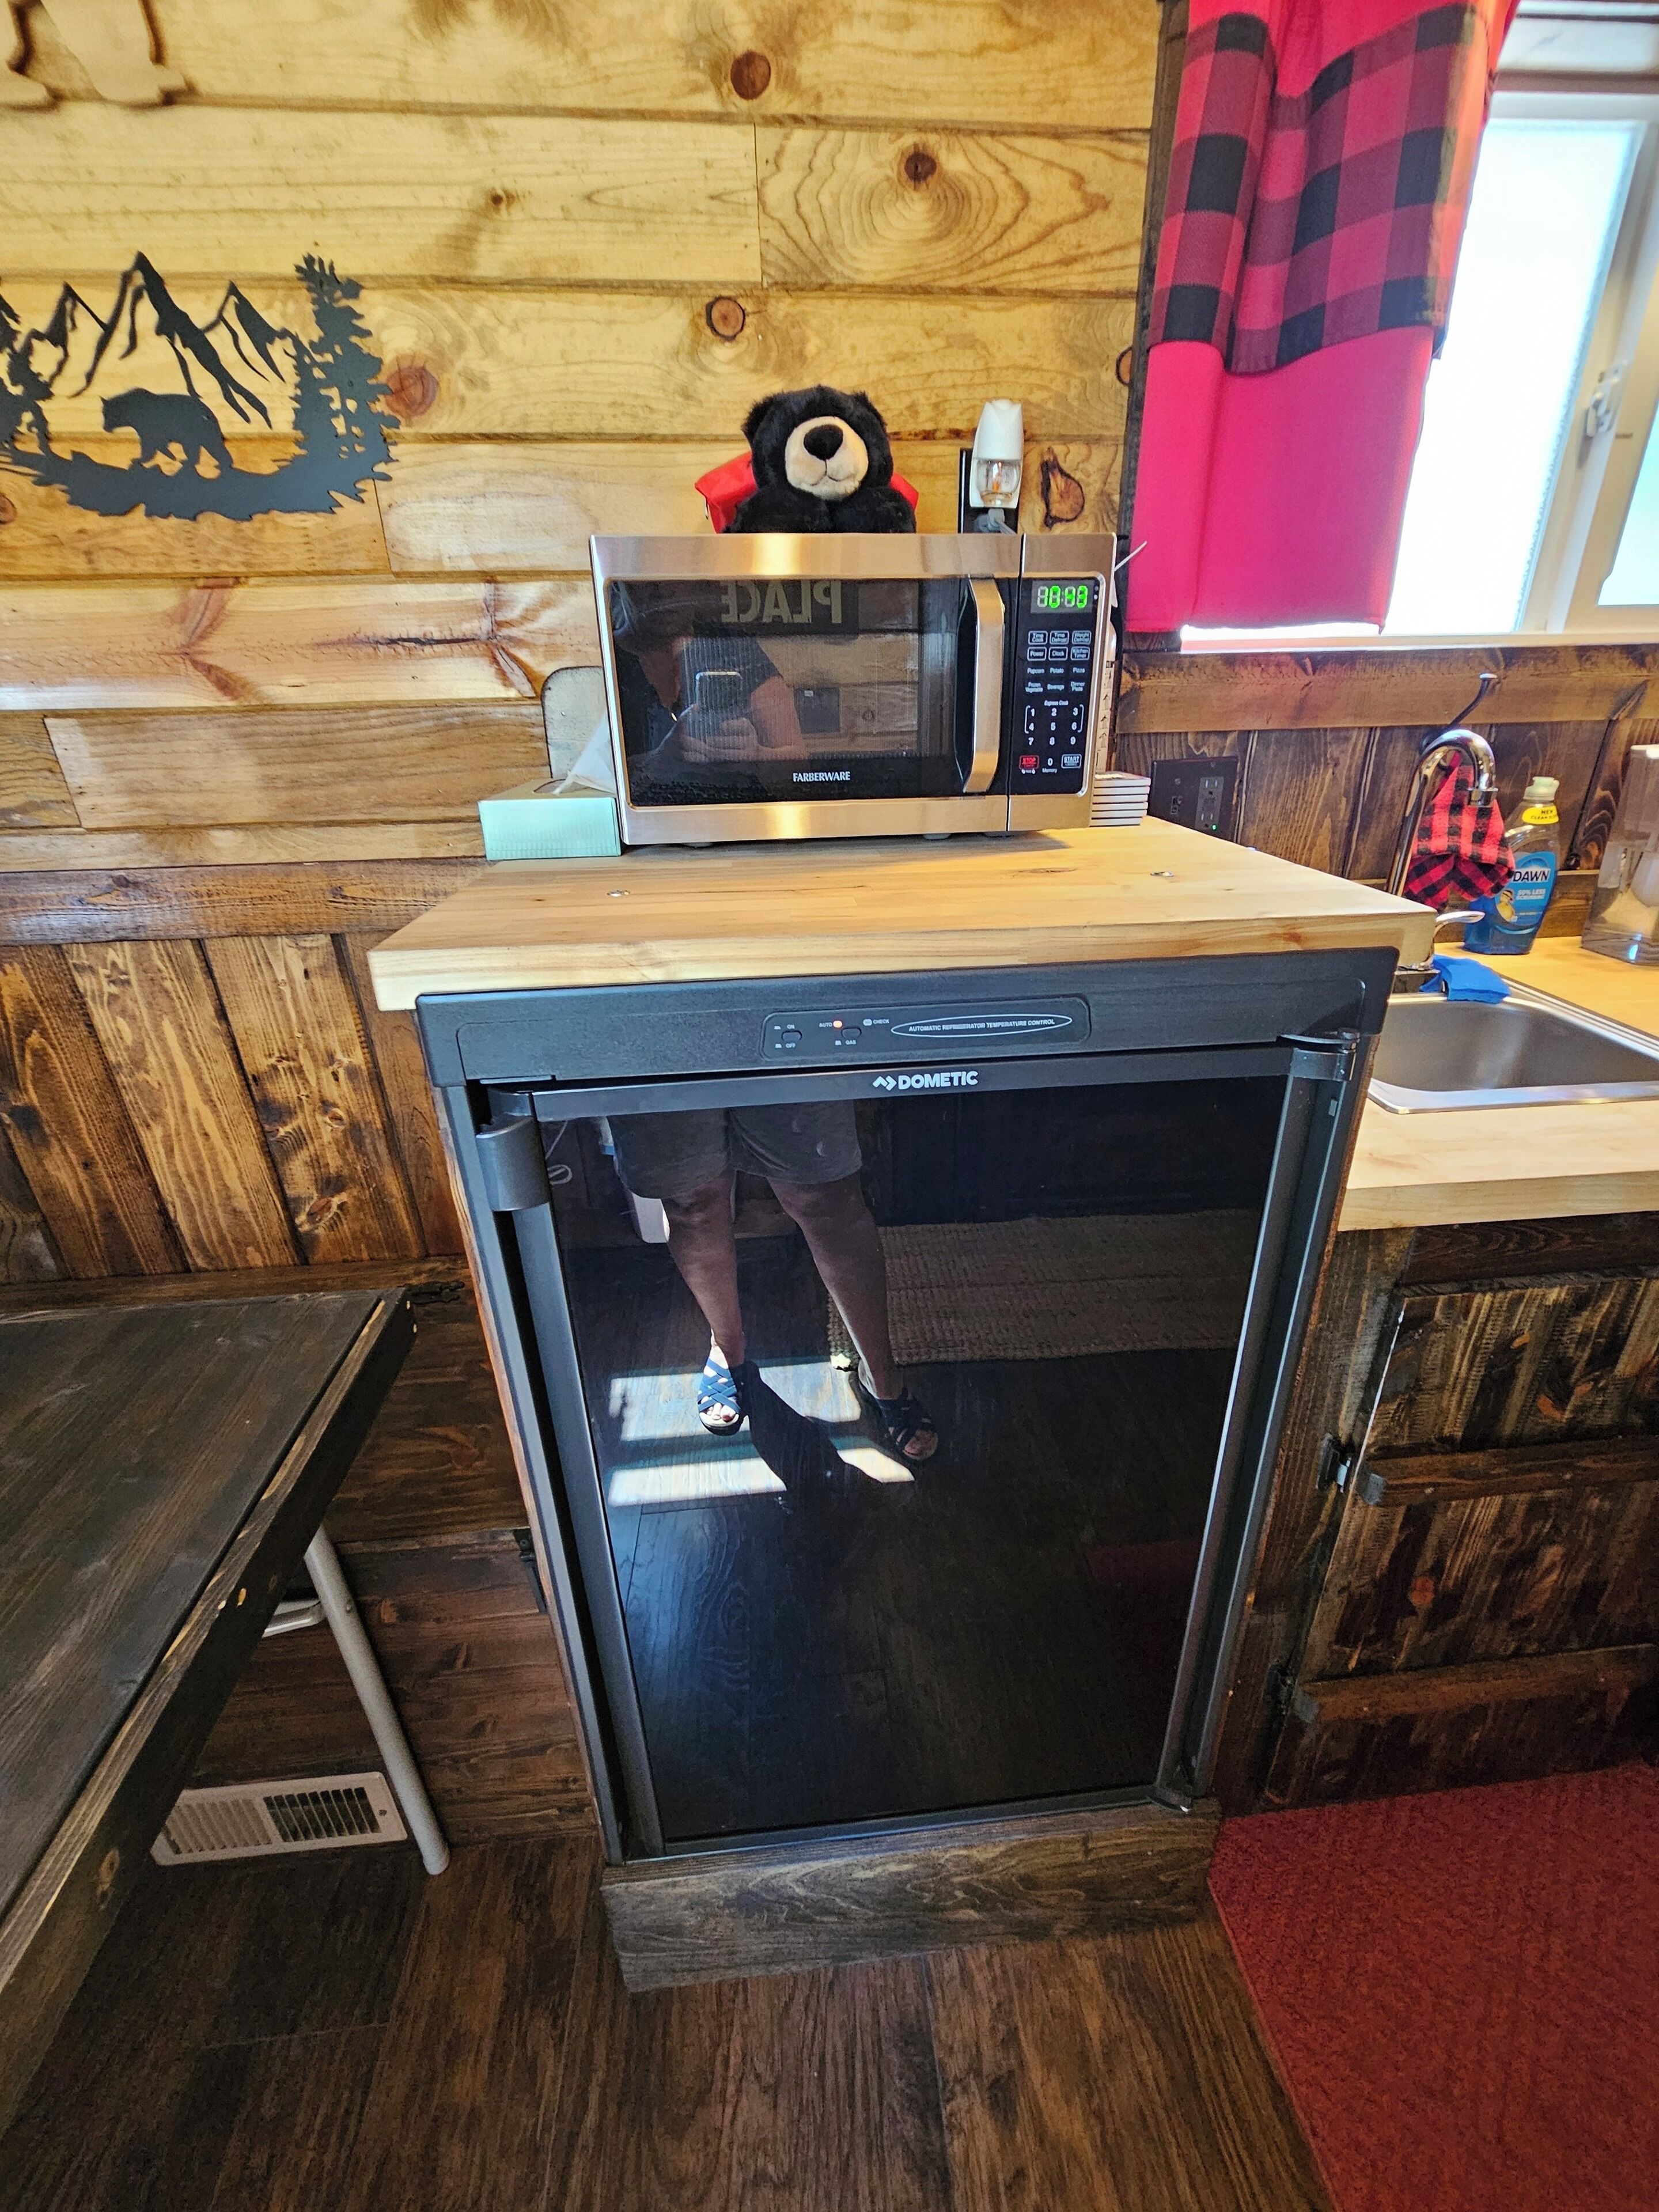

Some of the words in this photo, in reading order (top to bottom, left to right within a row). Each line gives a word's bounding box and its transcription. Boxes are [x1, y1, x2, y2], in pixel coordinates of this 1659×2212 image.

[1037, 585, 1088, 608] 10:43
[1031, 708, 1035, 717] 1
[1051, 707, 1057, 717] 2
[1073, 707, 1078, 716] 3
[1028, 722, 1035, 731] 4
[1050, 722, 1056, 731] 5
[1071, 721, 1077, 730] 6
[1028, 737, 1034, 745] 7
[1049, 737, 1055, 745] 8
[1070, 736, 1076, 745] 9
[1047, 757, 1053, 766] 0
[793, 771, 851, 782] FARBERWARE
[1513, 870, 1550, 882] DAWN
[986, 1020, 1027, 1028] TEMPERATURE
[897, 1070, 979, 1090] DOMETIC
